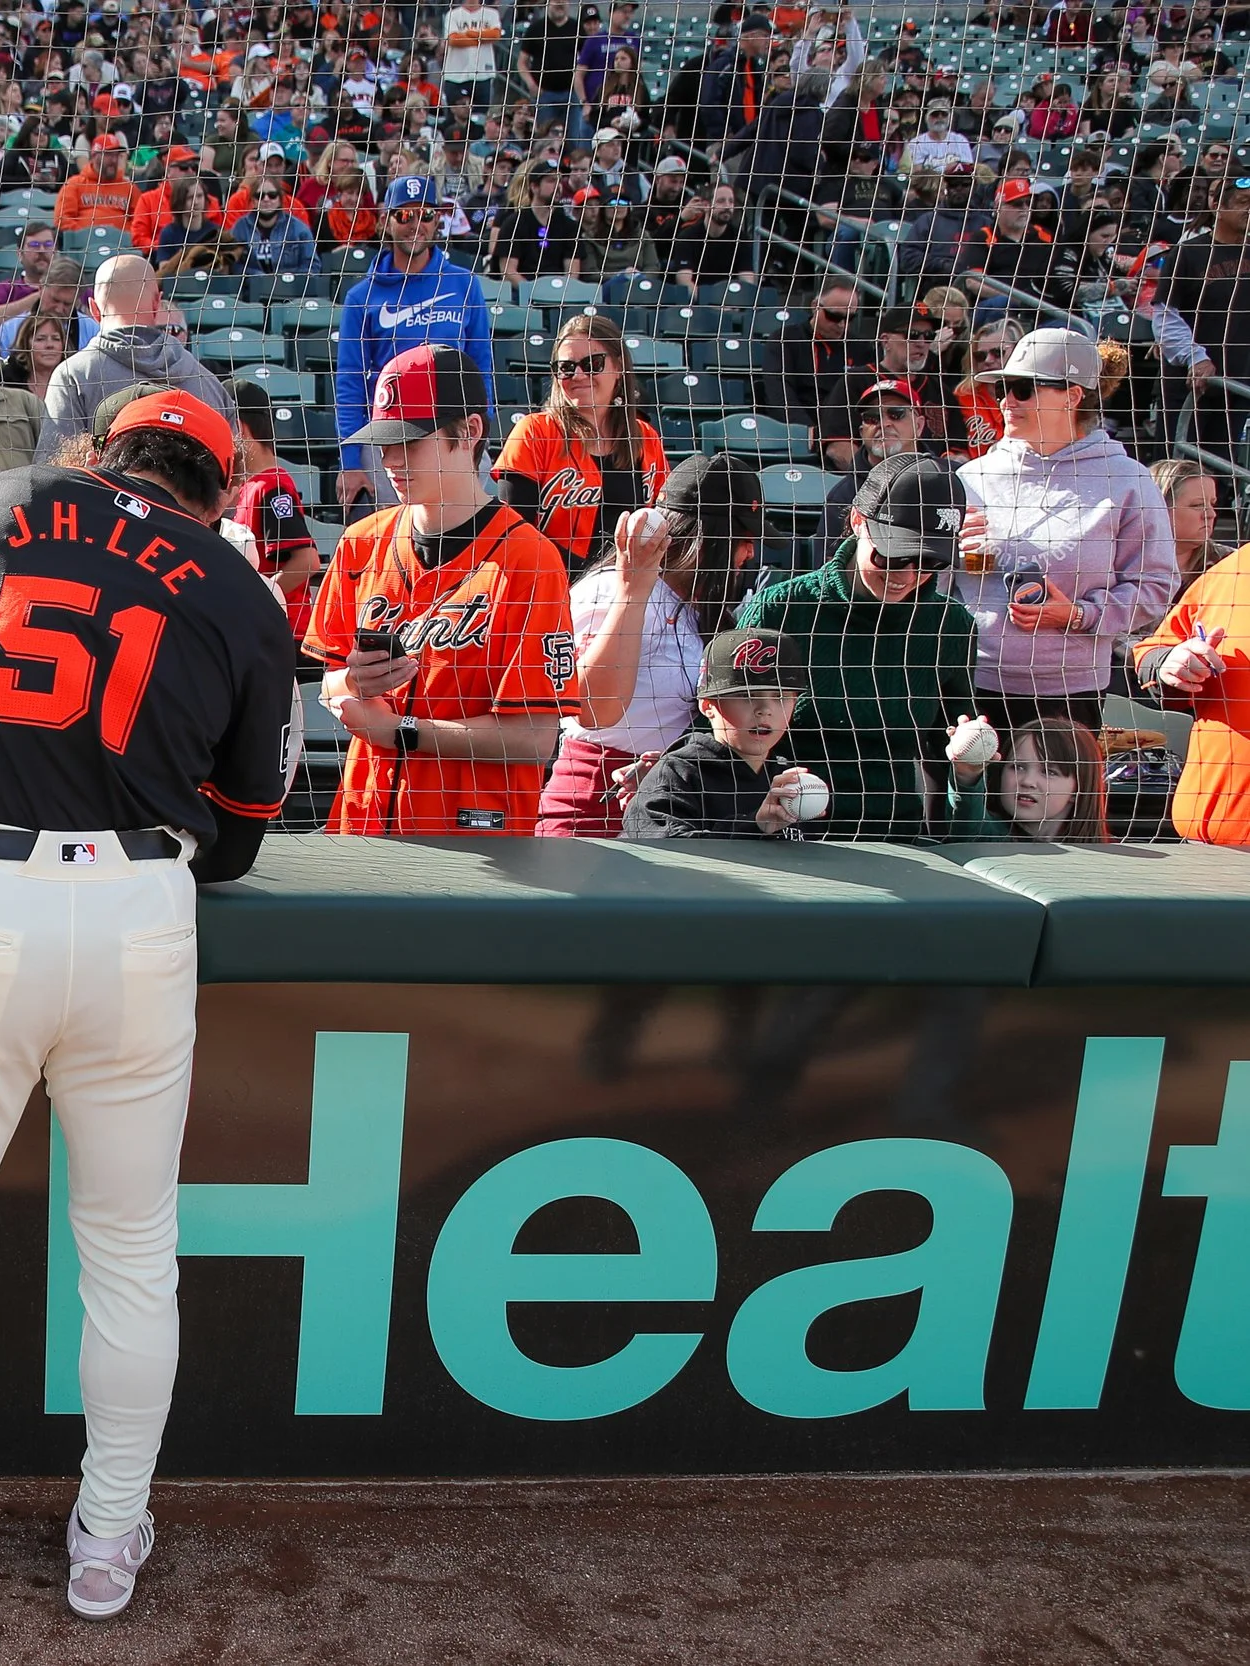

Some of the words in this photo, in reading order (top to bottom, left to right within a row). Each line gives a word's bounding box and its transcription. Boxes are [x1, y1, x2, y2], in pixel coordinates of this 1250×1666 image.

[406, 178, 421, 198] SF
[405, 311, 463, 327] BASEBALL
[7, 501, 94, 548] J.H.
[106, 518, 206, 595] LEE
[541, 631, 577, 692] SF
[730, 638, 776, 674] RC
